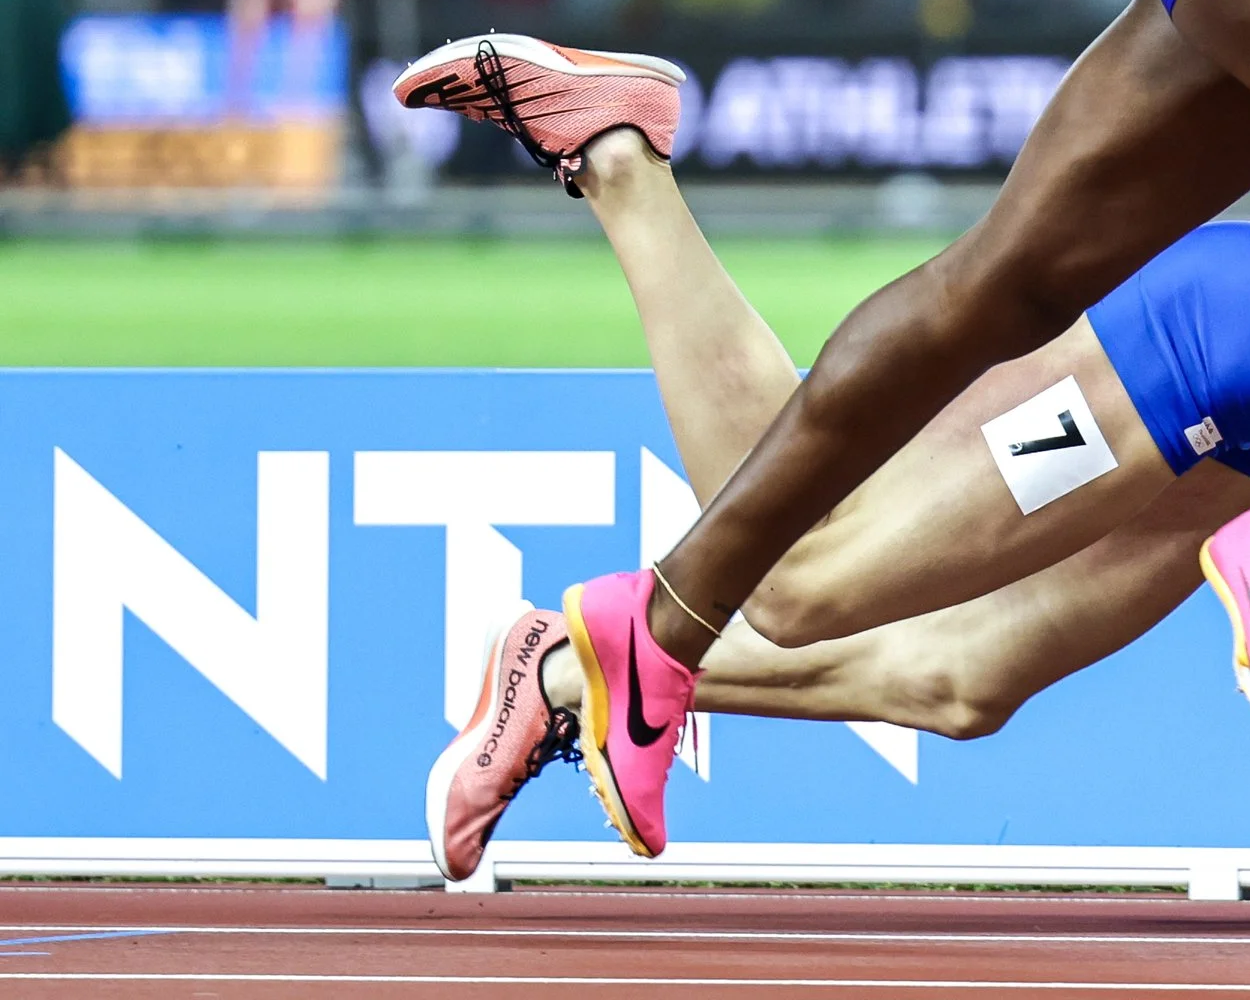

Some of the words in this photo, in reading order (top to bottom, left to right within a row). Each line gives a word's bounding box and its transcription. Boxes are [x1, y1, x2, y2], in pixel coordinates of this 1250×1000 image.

[1007, 409, 1087, 457] 7
[517, 619, 549, 666] new
[476, 668, 527, 768] balance
